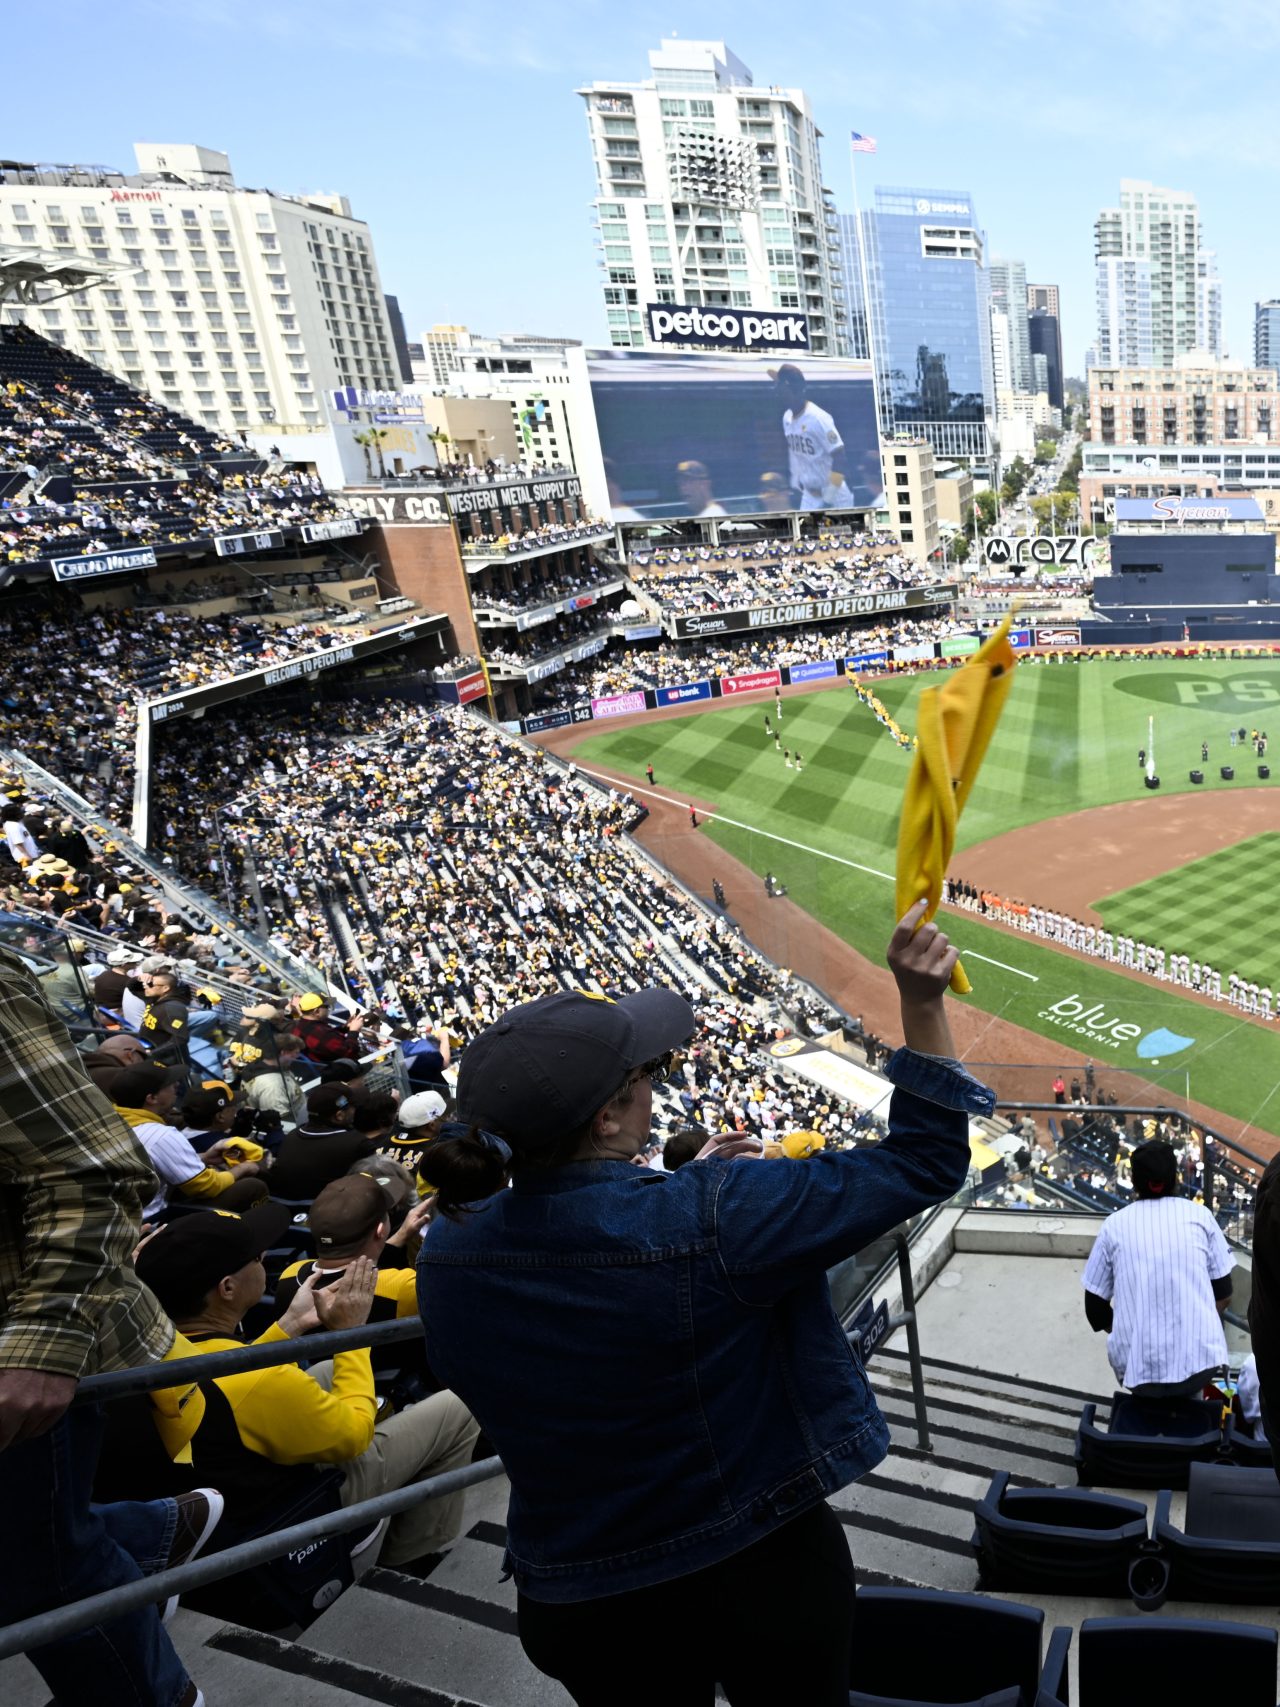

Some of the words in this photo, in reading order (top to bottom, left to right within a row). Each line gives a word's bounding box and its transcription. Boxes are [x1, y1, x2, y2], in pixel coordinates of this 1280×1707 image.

[110, 190, 162, 202] Marriott
[651, 307, 740, 341] petco
[742, 316, 806, 345] park
[405, 497, 449, 521] CO.
[450, 491, 499, 514] WESTERN
[501, 485, 532, 506] METAL
[534, 481, 565, 501] SUPPLY
[567, 478, 582, 496] CO.
[1152, 495, 1232, 526] Sycuan
[1016, 538, 1096, 570] razr
[749, 605, 813, 627] WELCOME
[815, 603, 832, 618] TO
[834, 598, 874, 615] PETCO
[875, 592, 907, 610] PARK
[923, 588, 953, 602] Sycuan
[685, 617, 727, 634] Sycuan
[264, 663, 302, 686] WELCOME
[302, 660, 313, 674] TO
[313, 655, 335, 671] PETCO
[335, 648, 354, 667] PARK
[738, 674, 778, 689] Snapdragon
[679, 686, 700, 698] bank
[152, 704, 168, 721] DAY
[574, 709, 590, 721] 342
[1038, 1011, 1120, 1049] CALIFORNIA
[1048, 994, 1142, 1041] blue
[863, 1315, 885, 1355] 302
